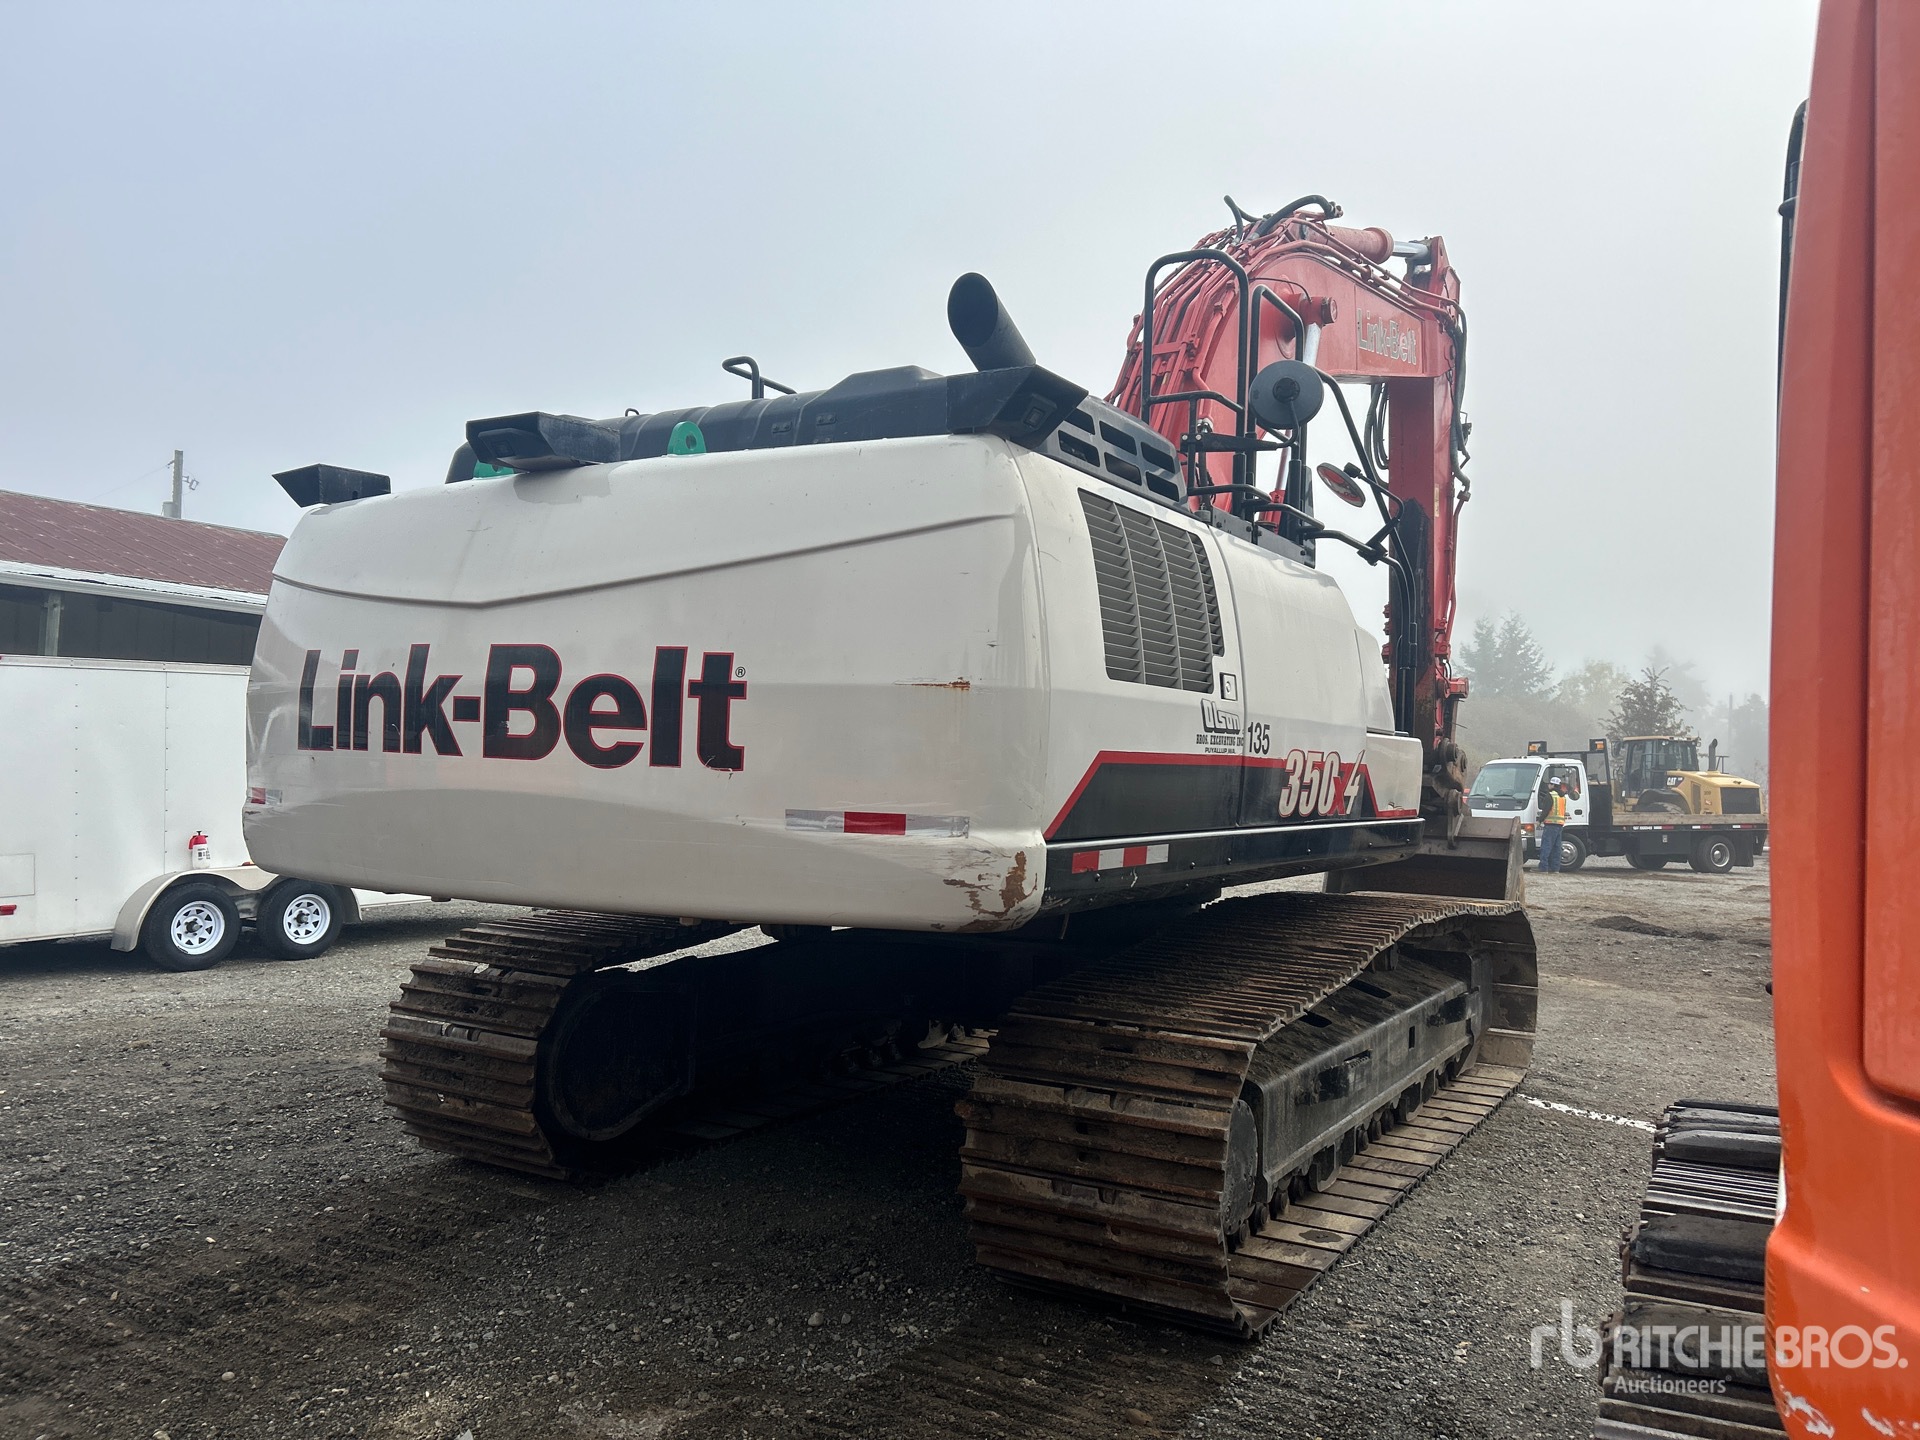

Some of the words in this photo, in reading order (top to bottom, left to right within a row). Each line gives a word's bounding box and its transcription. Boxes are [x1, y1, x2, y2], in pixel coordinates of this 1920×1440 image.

[1357, 308, 1417, 365] Link-Belt
[1210, 735, 1236, 746] EXCAVATING
[1247, 721, 1271, 755] 135
[1666, 776, 1677, 786] CAT
